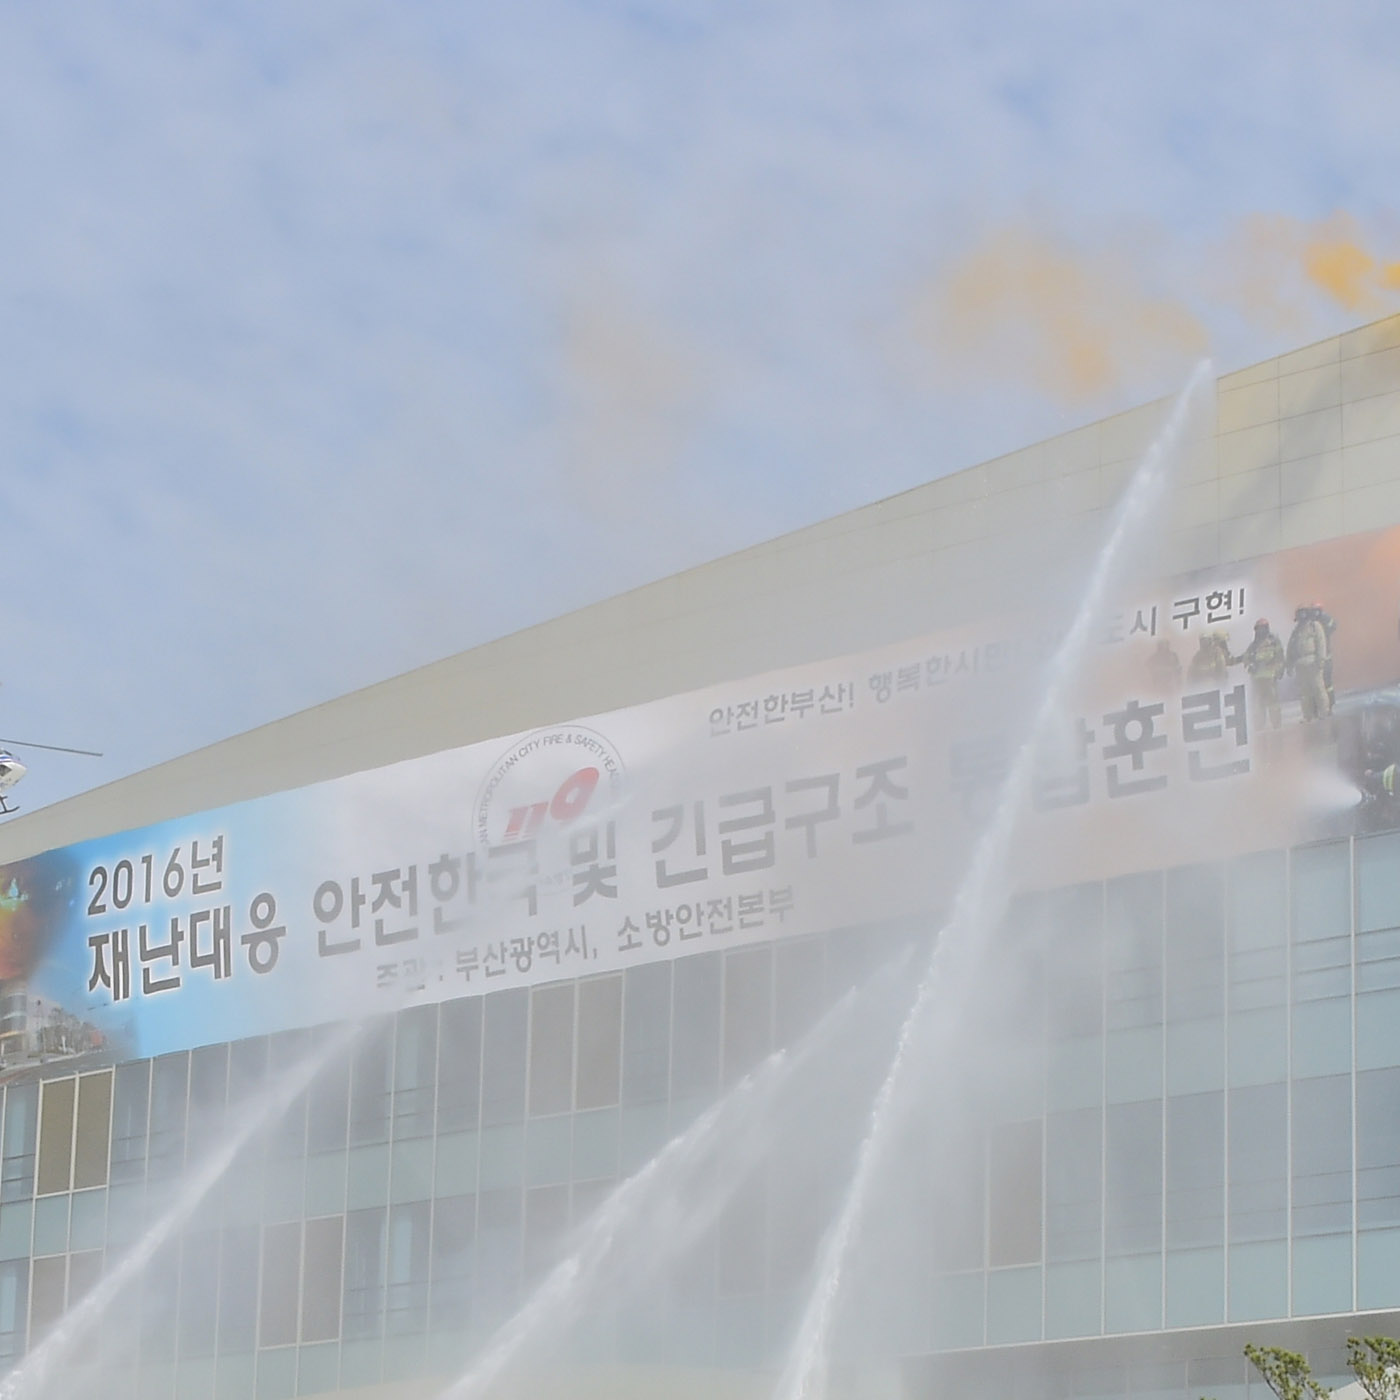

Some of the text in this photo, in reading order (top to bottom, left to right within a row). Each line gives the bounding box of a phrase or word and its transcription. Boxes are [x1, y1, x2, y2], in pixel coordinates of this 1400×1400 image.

[708, 681, 855, 738] 안전한부산!
[1172, 587, 1247, 630] 구현!
[517, 738, 542, 759] CITY
[542, 732, 566, 748] FIRE
[574, 734, 607, 760] SAFETY
[87, 834, 224, 917] 2016년
[87, 891, 287, 1002] 재난대응
[568, 820, 618, 905] 및
[651, 757, 915, 889] 긴급구조
[616, 884, 795, 952] 소방안전본부
